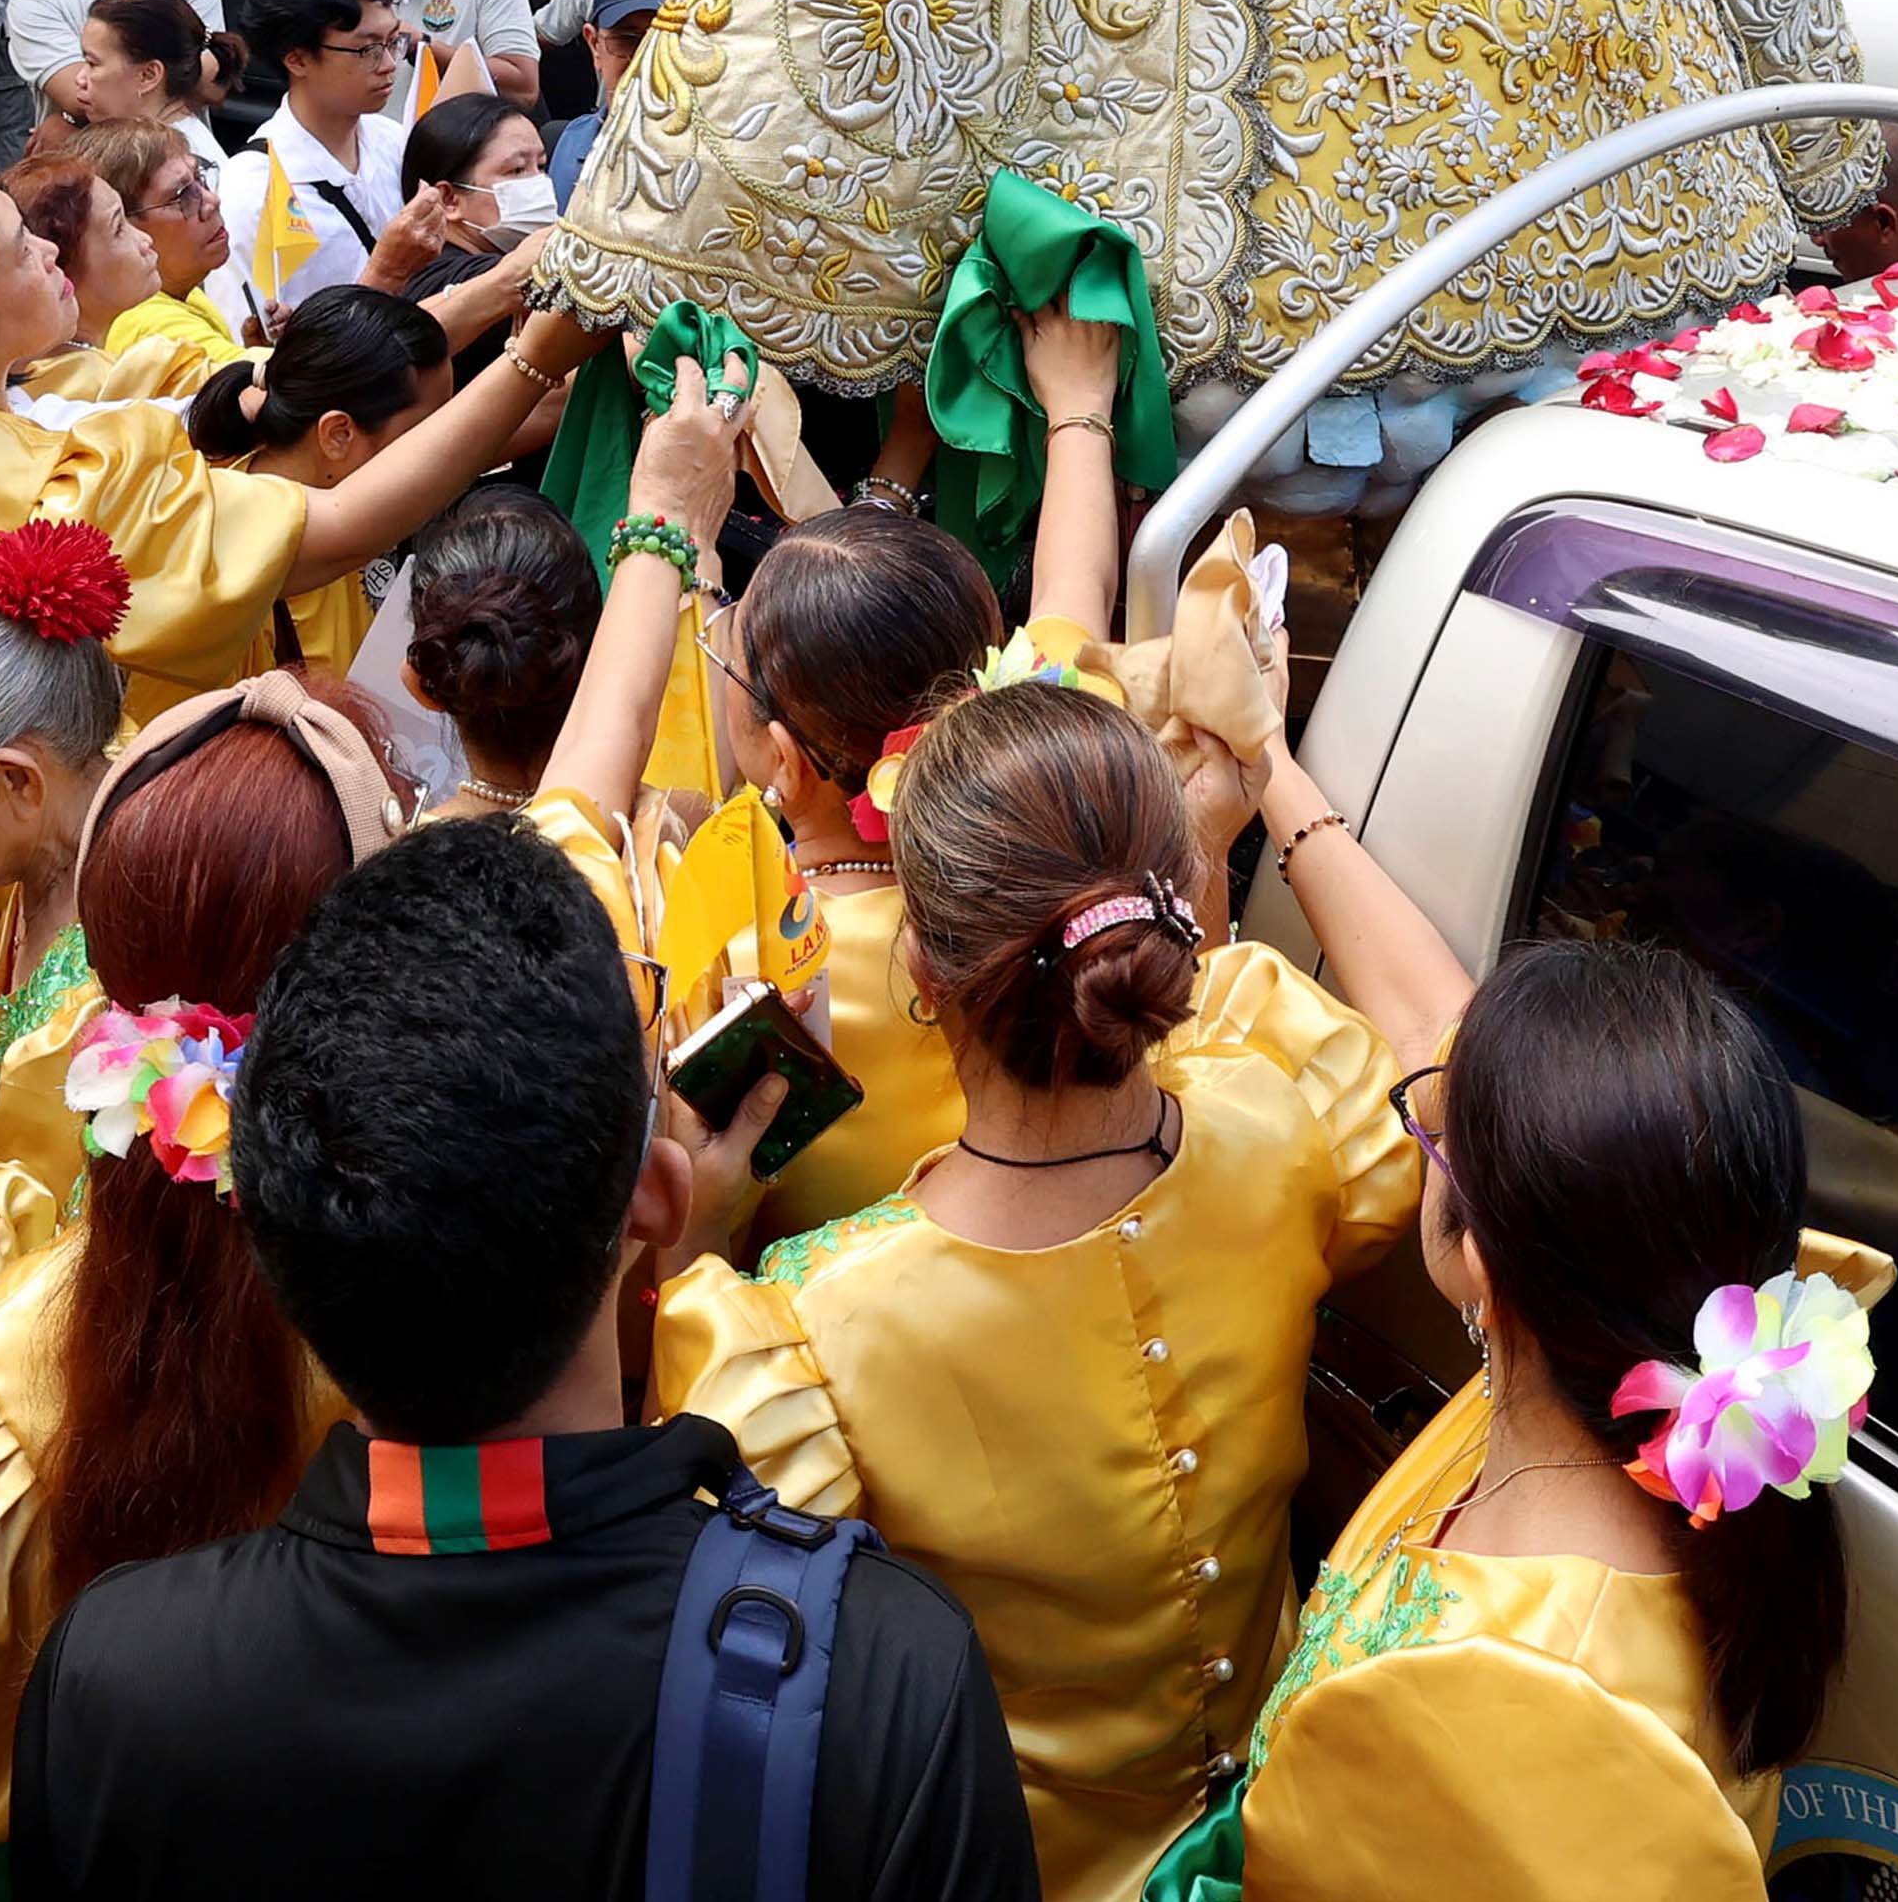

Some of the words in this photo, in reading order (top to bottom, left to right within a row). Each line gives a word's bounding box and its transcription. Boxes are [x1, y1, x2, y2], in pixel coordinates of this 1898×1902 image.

[366, 561, 395, 593] IHS
[790, 935, 815, 965] LA
[1783, 1782, 1825, 1820] OF
